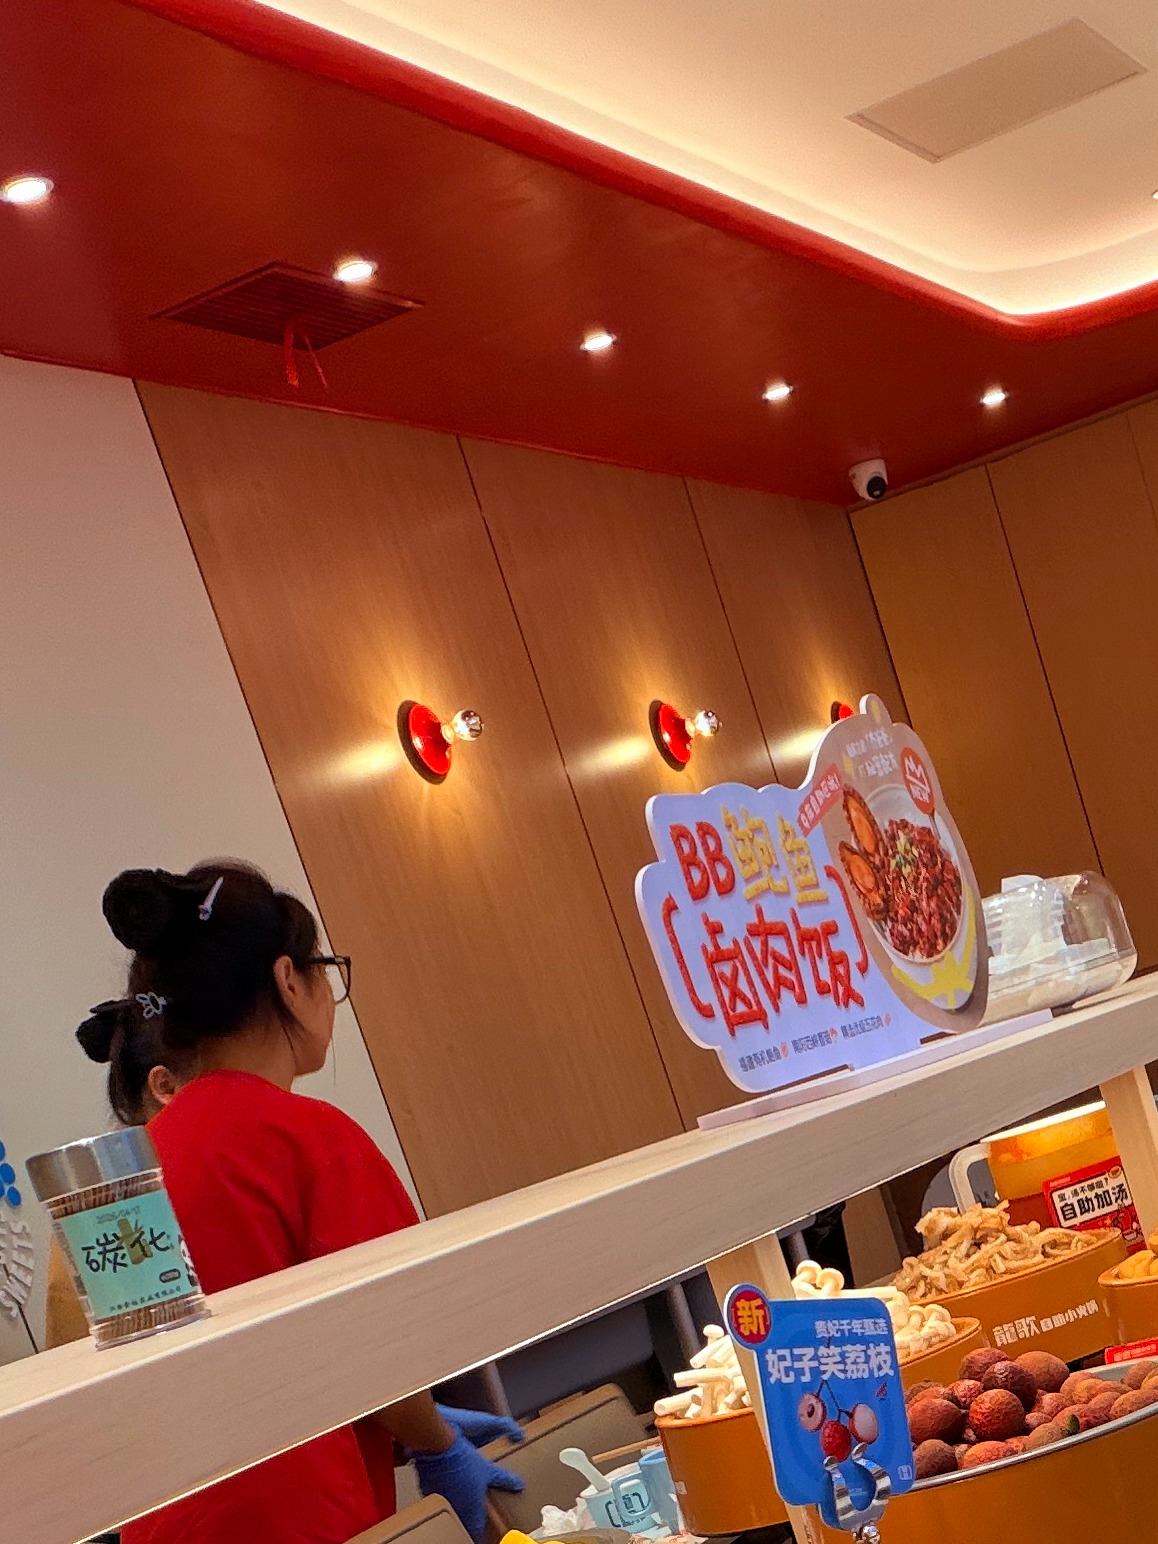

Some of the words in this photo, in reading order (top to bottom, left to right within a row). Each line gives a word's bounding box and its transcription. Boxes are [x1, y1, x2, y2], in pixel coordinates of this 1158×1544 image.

[1060, 1184, 1128, 1221] 自助加汤
[733, 1299, 766, 1336] 新
[766, 1343, 894, 1384] 妃子笑荔枝
